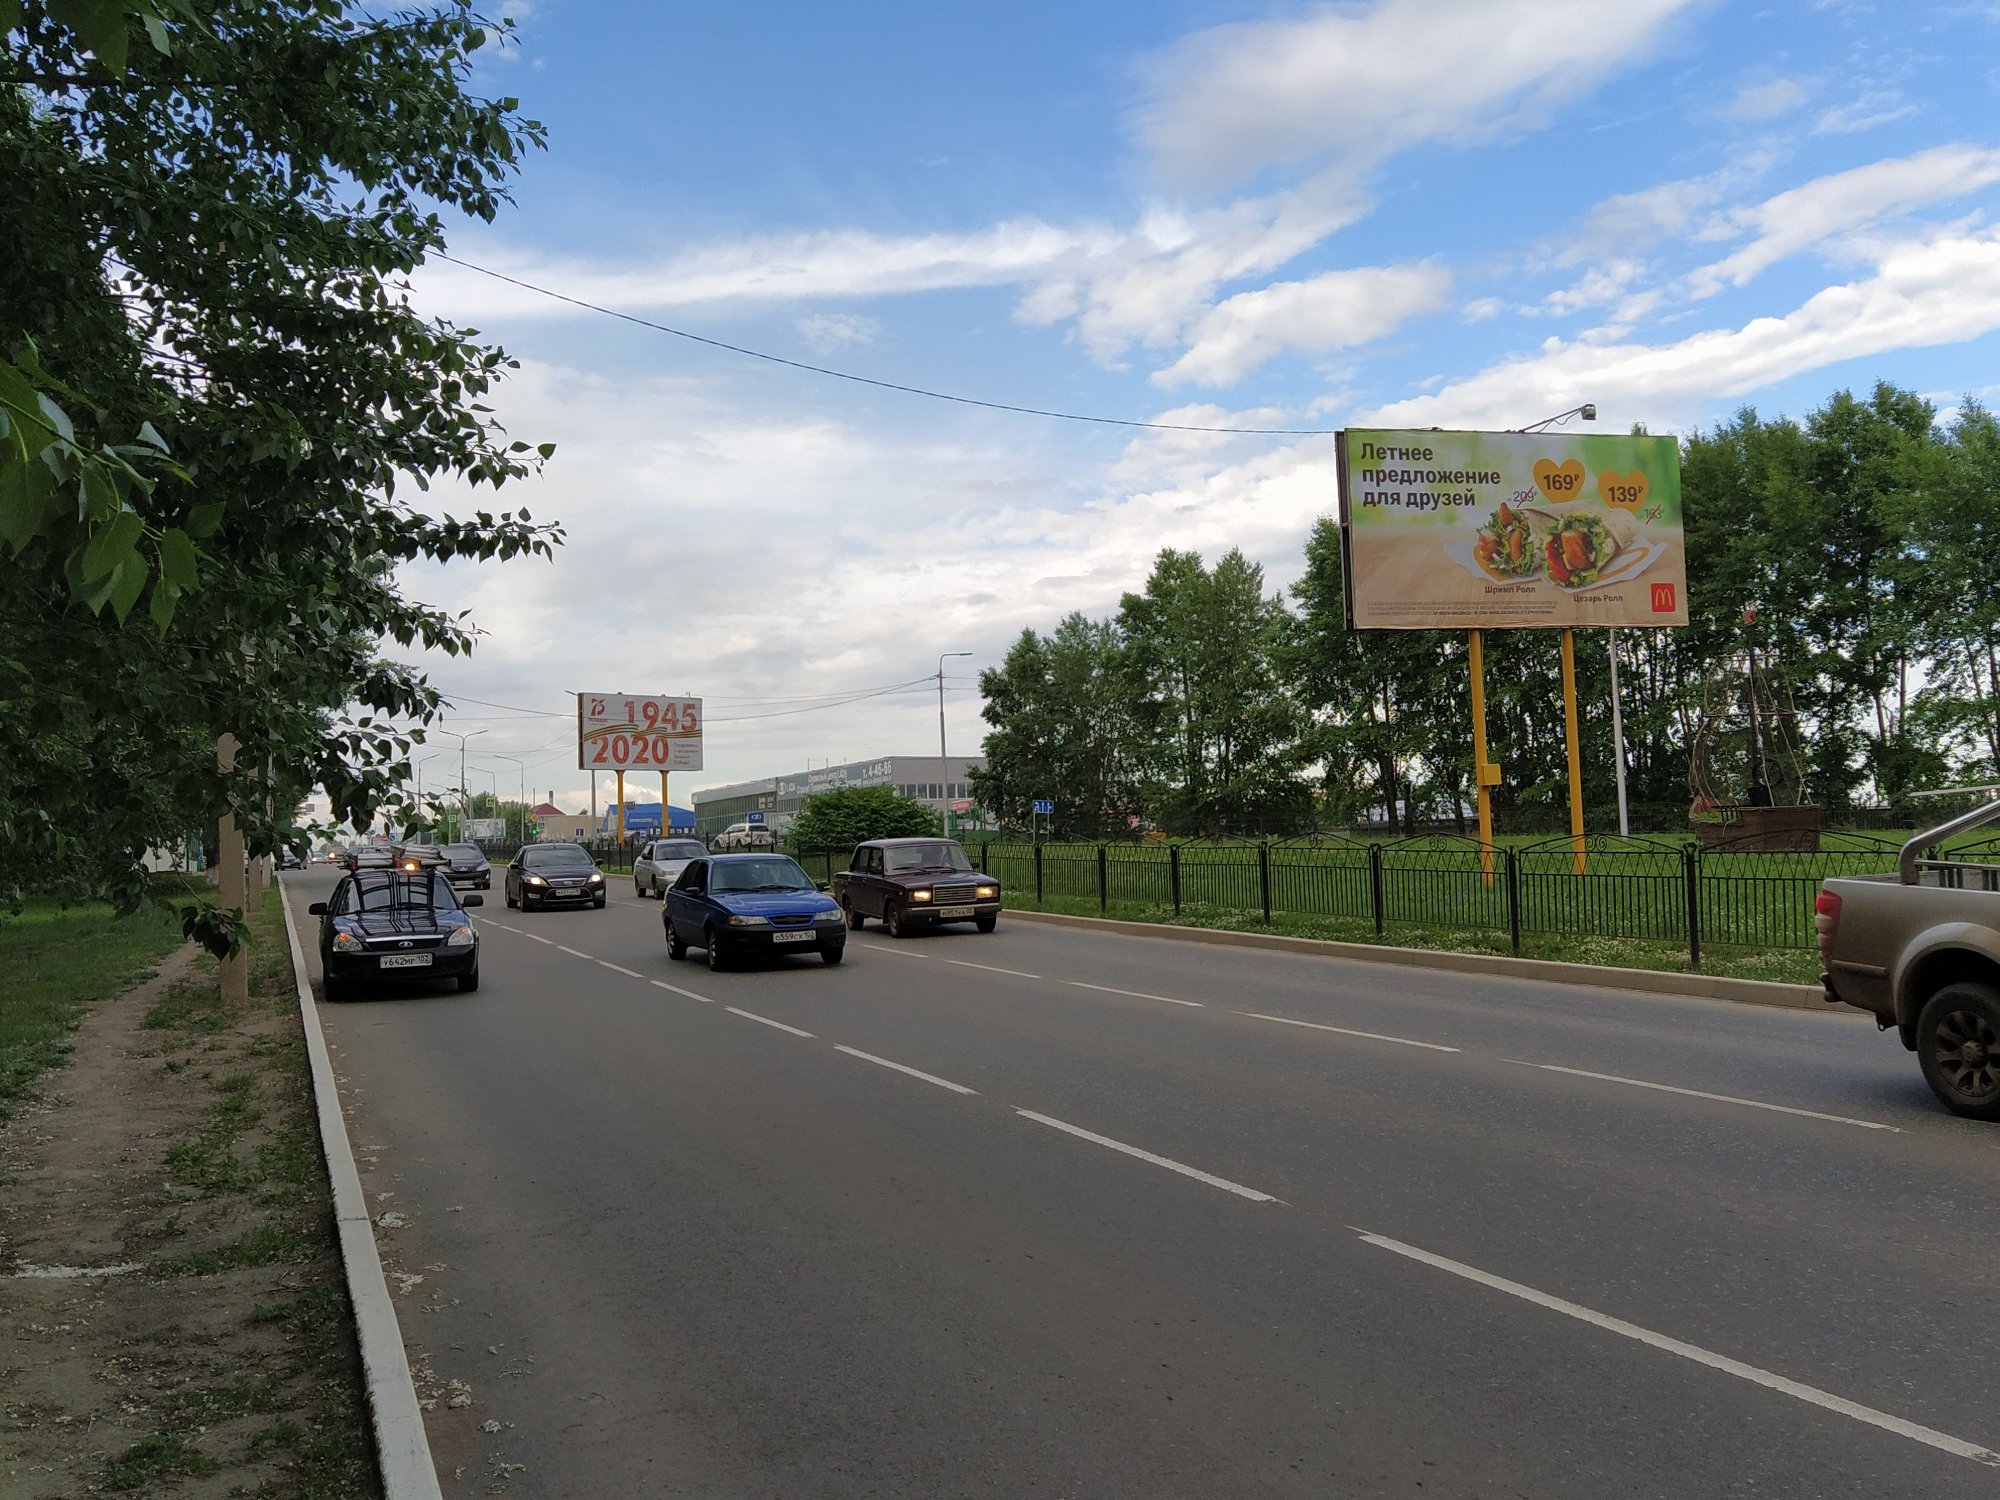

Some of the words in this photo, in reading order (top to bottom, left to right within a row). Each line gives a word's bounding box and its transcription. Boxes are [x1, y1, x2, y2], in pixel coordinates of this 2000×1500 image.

[1361, 442, 1434, 461] Летнее
[1362, 468, 1502, 487] предложение
[1363, 491, 1401, 508] для
[1405, 488, 1476, 511] друзей
[1484, 585, 1514, 595] Шримп
[1516, 585, 1536, 594] Ролл
[1573, 594, 1603, 604] Цезарь
[1603, 594, 1624, 602] Ролл
[623, 700, 698, 731] 1945
[590, 734, 669, 765] 2020
[383, 957, 416, 967] У642МР
